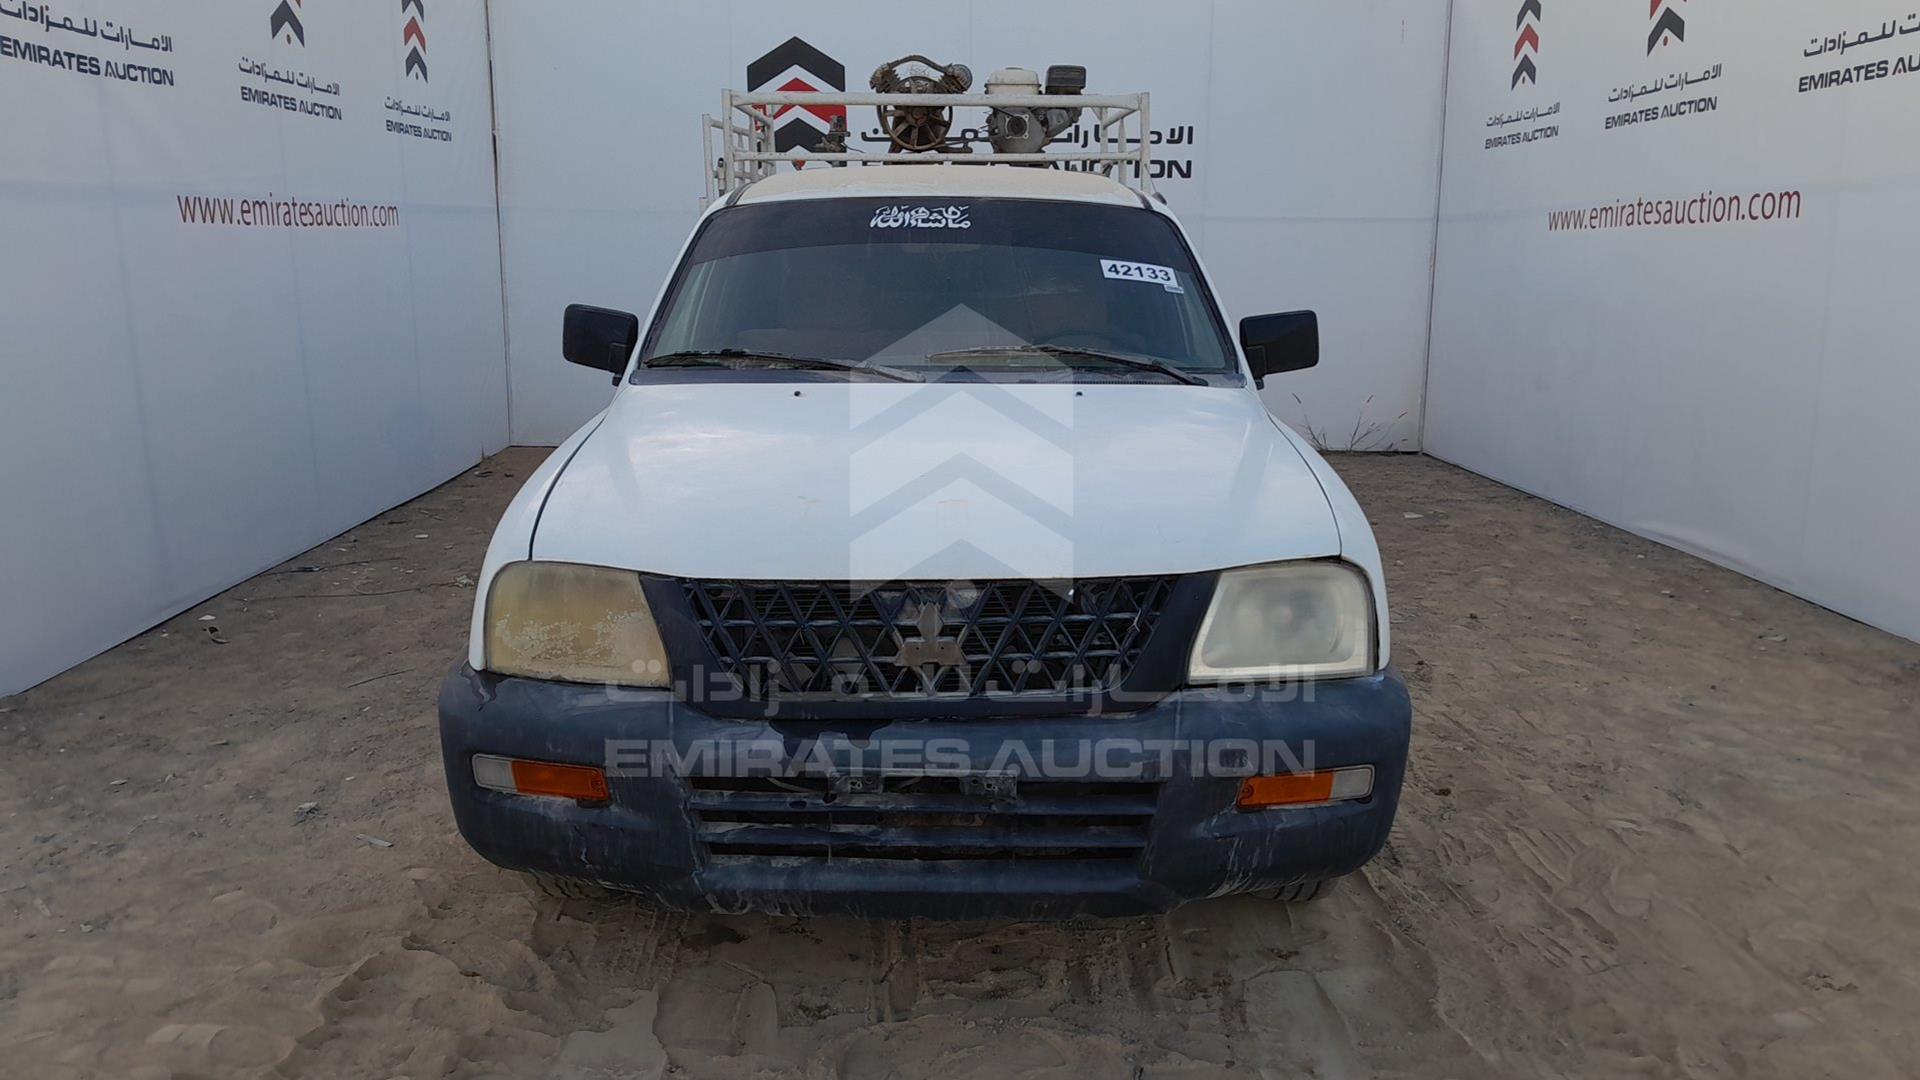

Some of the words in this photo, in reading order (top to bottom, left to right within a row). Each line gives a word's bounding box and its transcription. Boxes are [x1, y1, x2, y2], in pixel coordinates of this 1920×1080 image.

[0, 35, 100, 76] EMIRATES
[104, 60, 174, 86] AUCTION
[1798, 59, 1889, 93] EMIRATES
[240, 86, 297, 112] EMIRATES
[299, 100, 342, 120] AUCTION
[1605, 106, 1659, 130] EMIRATES
[1660, 96, 1718, 120] AUCTION
[385, 119, 422, 138] EMIRATES
[423, 127, 452, 142] AUCTION
[1485, 132, 1521, 150] EMIRATES
[1522, 125, 1560, 143] AUCTION
[177, 192, 400, 227] www.emiratesauction.com
[1548, 190, 1801, 231] www.emiratesauction.com
[1107, 263, 1171, 281] 42133
